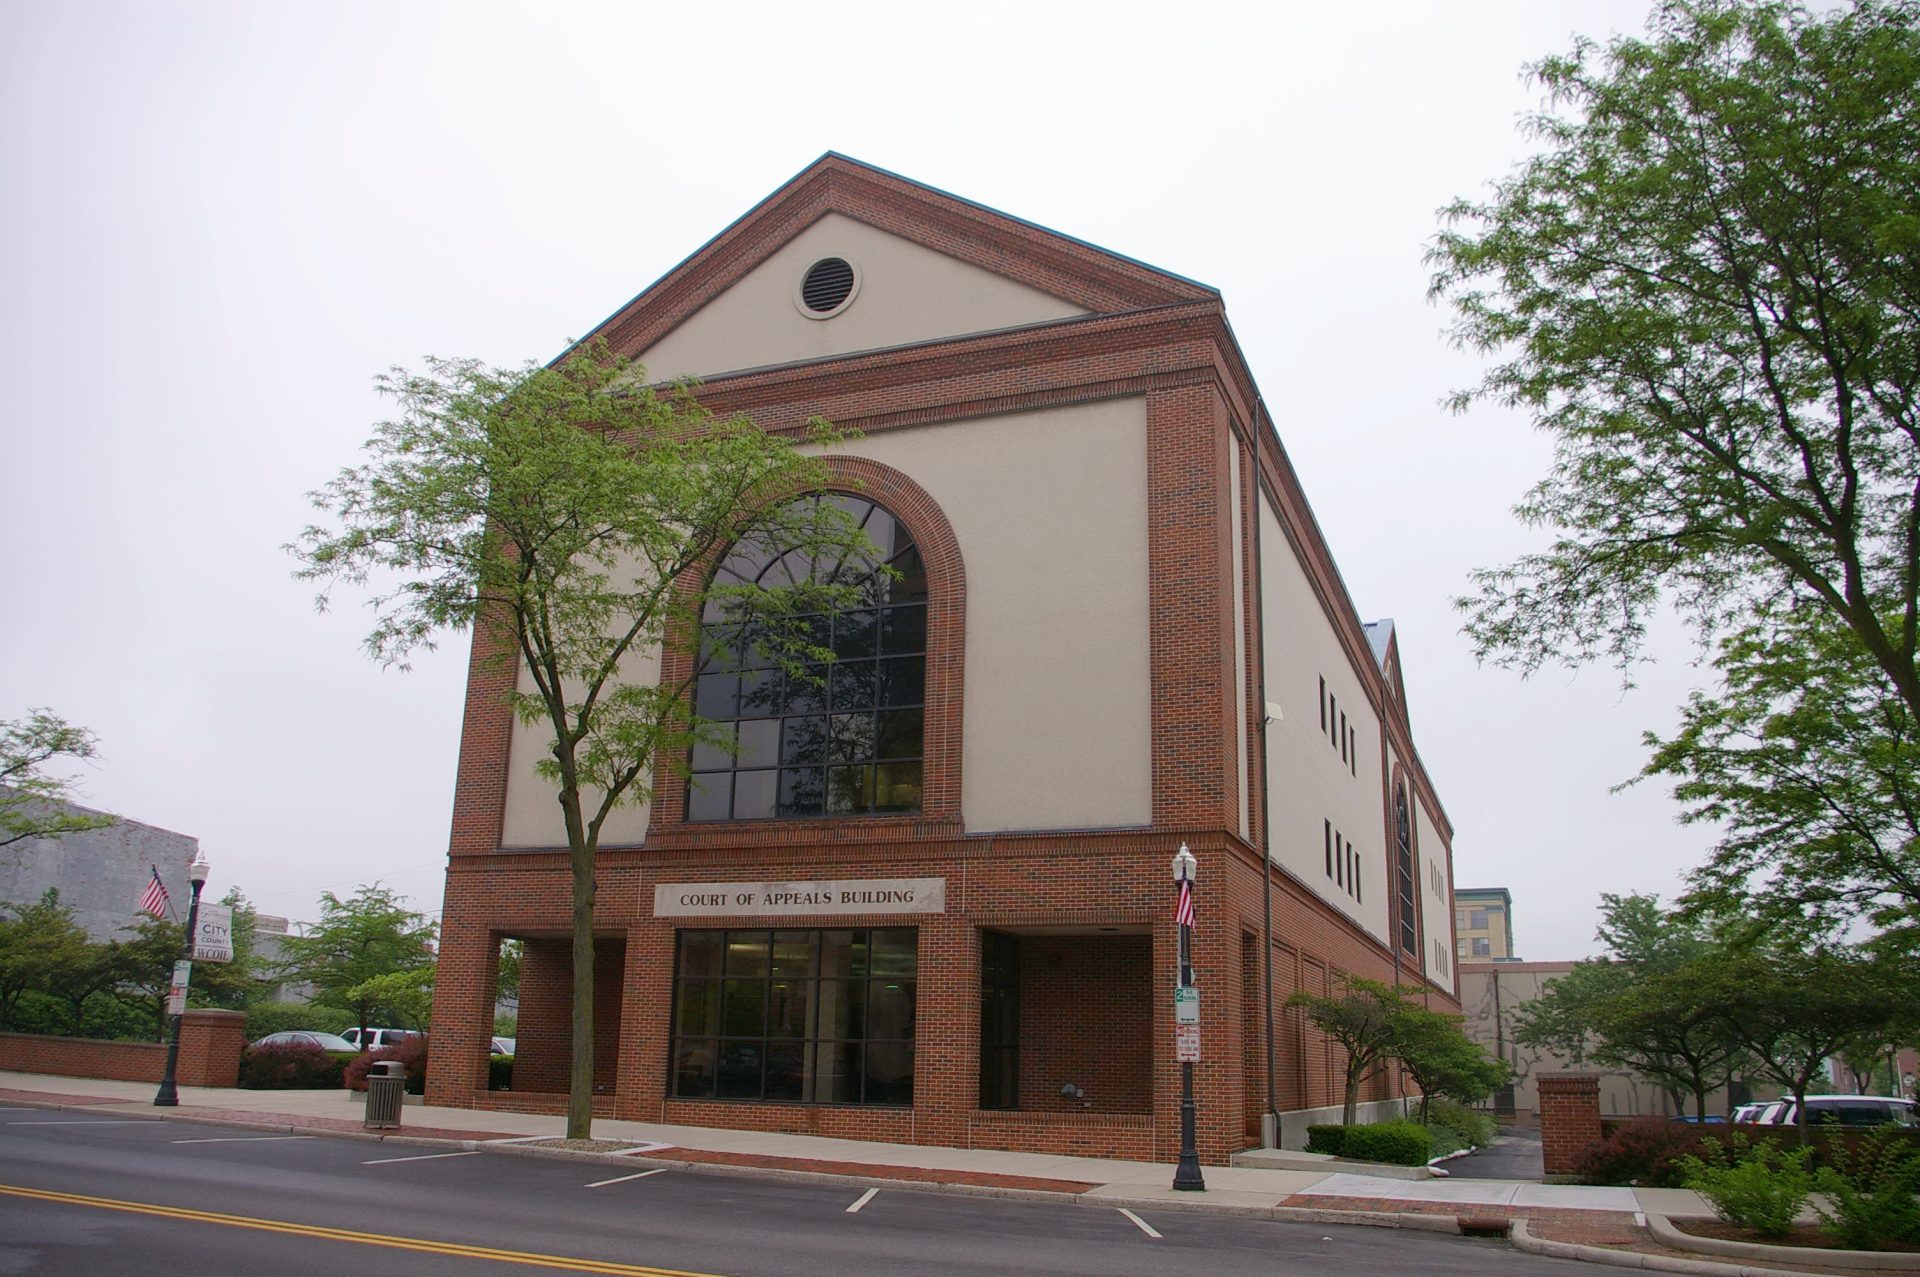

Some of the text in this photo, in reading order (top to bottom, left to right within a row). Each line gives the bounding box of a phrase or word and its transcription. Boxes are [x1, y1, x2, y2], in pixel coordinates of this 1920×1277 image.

[680, 890, 914, 906] COURT OF APPEALS BUILDING
[202, 924, 228, 936] CITY
[1176, 990, 1183, 1000] 2
